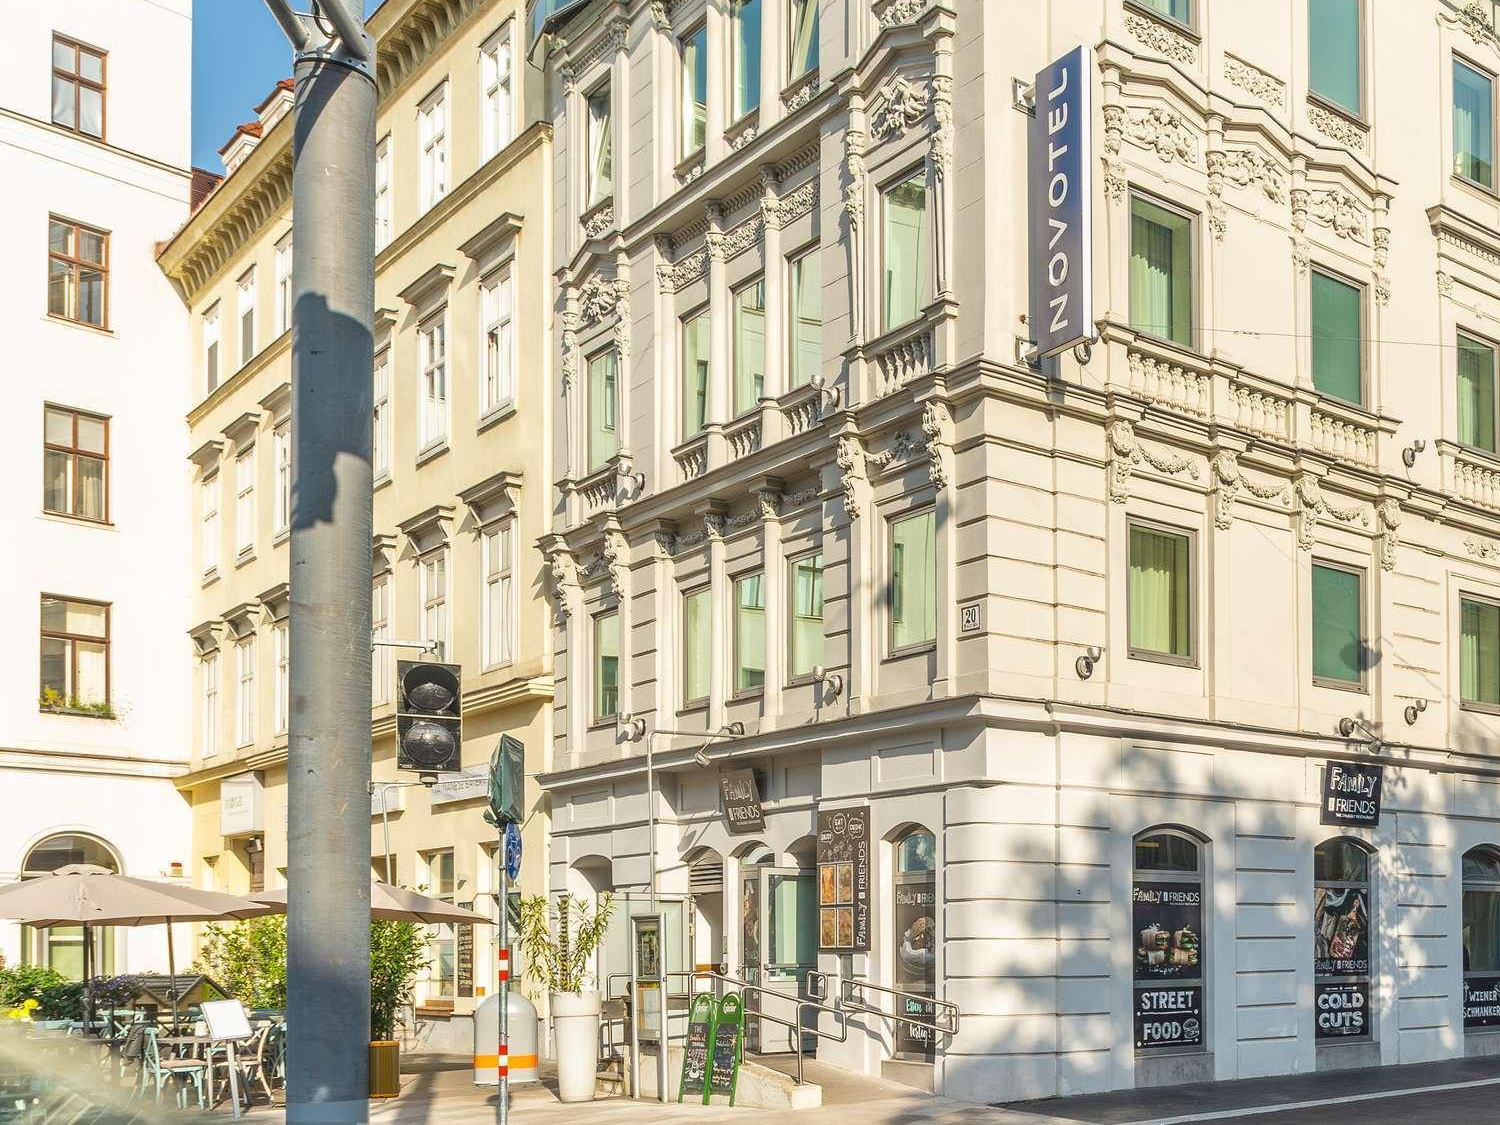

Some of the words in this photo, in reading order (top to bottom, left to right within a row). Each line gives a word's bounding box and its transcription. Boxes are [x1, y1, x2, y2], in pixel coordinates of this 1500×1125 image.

[1047, 66, 1069, 334] NOVOTEL
[965, 608, 976, 624] 20
[721, 778, 754, 801] FAMILY
[1330, 766, 1377, 797] FAMILY
[732, 805, 760, 820] FRIENDS
[1336, 798, 1376, 815] FRIENDS
[858, 841, 866, 890] FRIENDS
[1133, 887, 1162, 904] FAMILY
[1169, 891, 1200, 902] FRIENDS
[857, 902, 867, 947] FAMILY
[1342, 960, 1368, 969] FRIENDS
[1141, 990, 1194, 1010] STREET
[1318, 992, 1364, 1010] COLD
[1469, 990, 1498, 1002] WIENER
[1318, 1011, 1364, 1028] CUTS
[1143, 1022, 1182, 1040] FOOD
